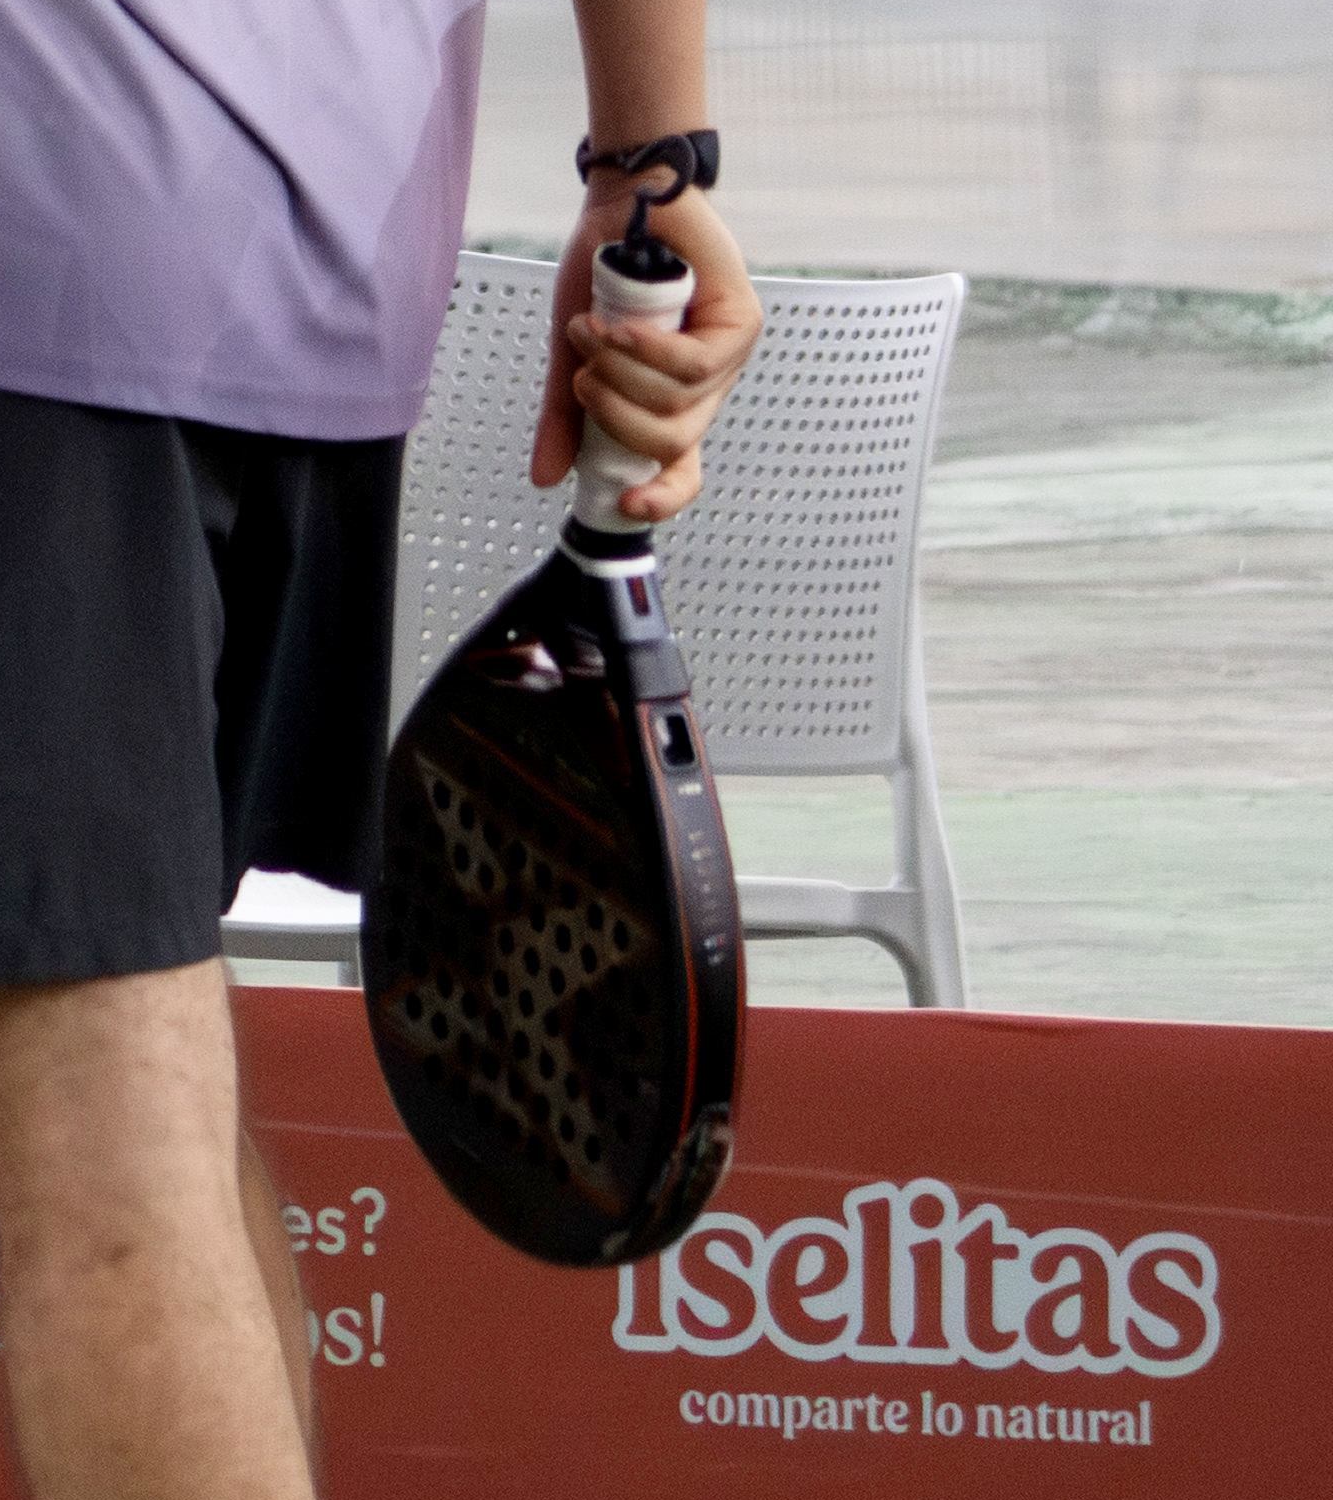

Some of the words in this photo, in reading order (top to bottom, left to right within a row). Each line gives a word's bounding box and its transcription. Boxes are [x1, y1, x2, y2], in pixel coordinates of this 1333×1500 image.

[680, 1390, 909, 1440] comparte
[922, 1391, 964, 1437] lo
[976, 1400, 1151, 1446] natural
